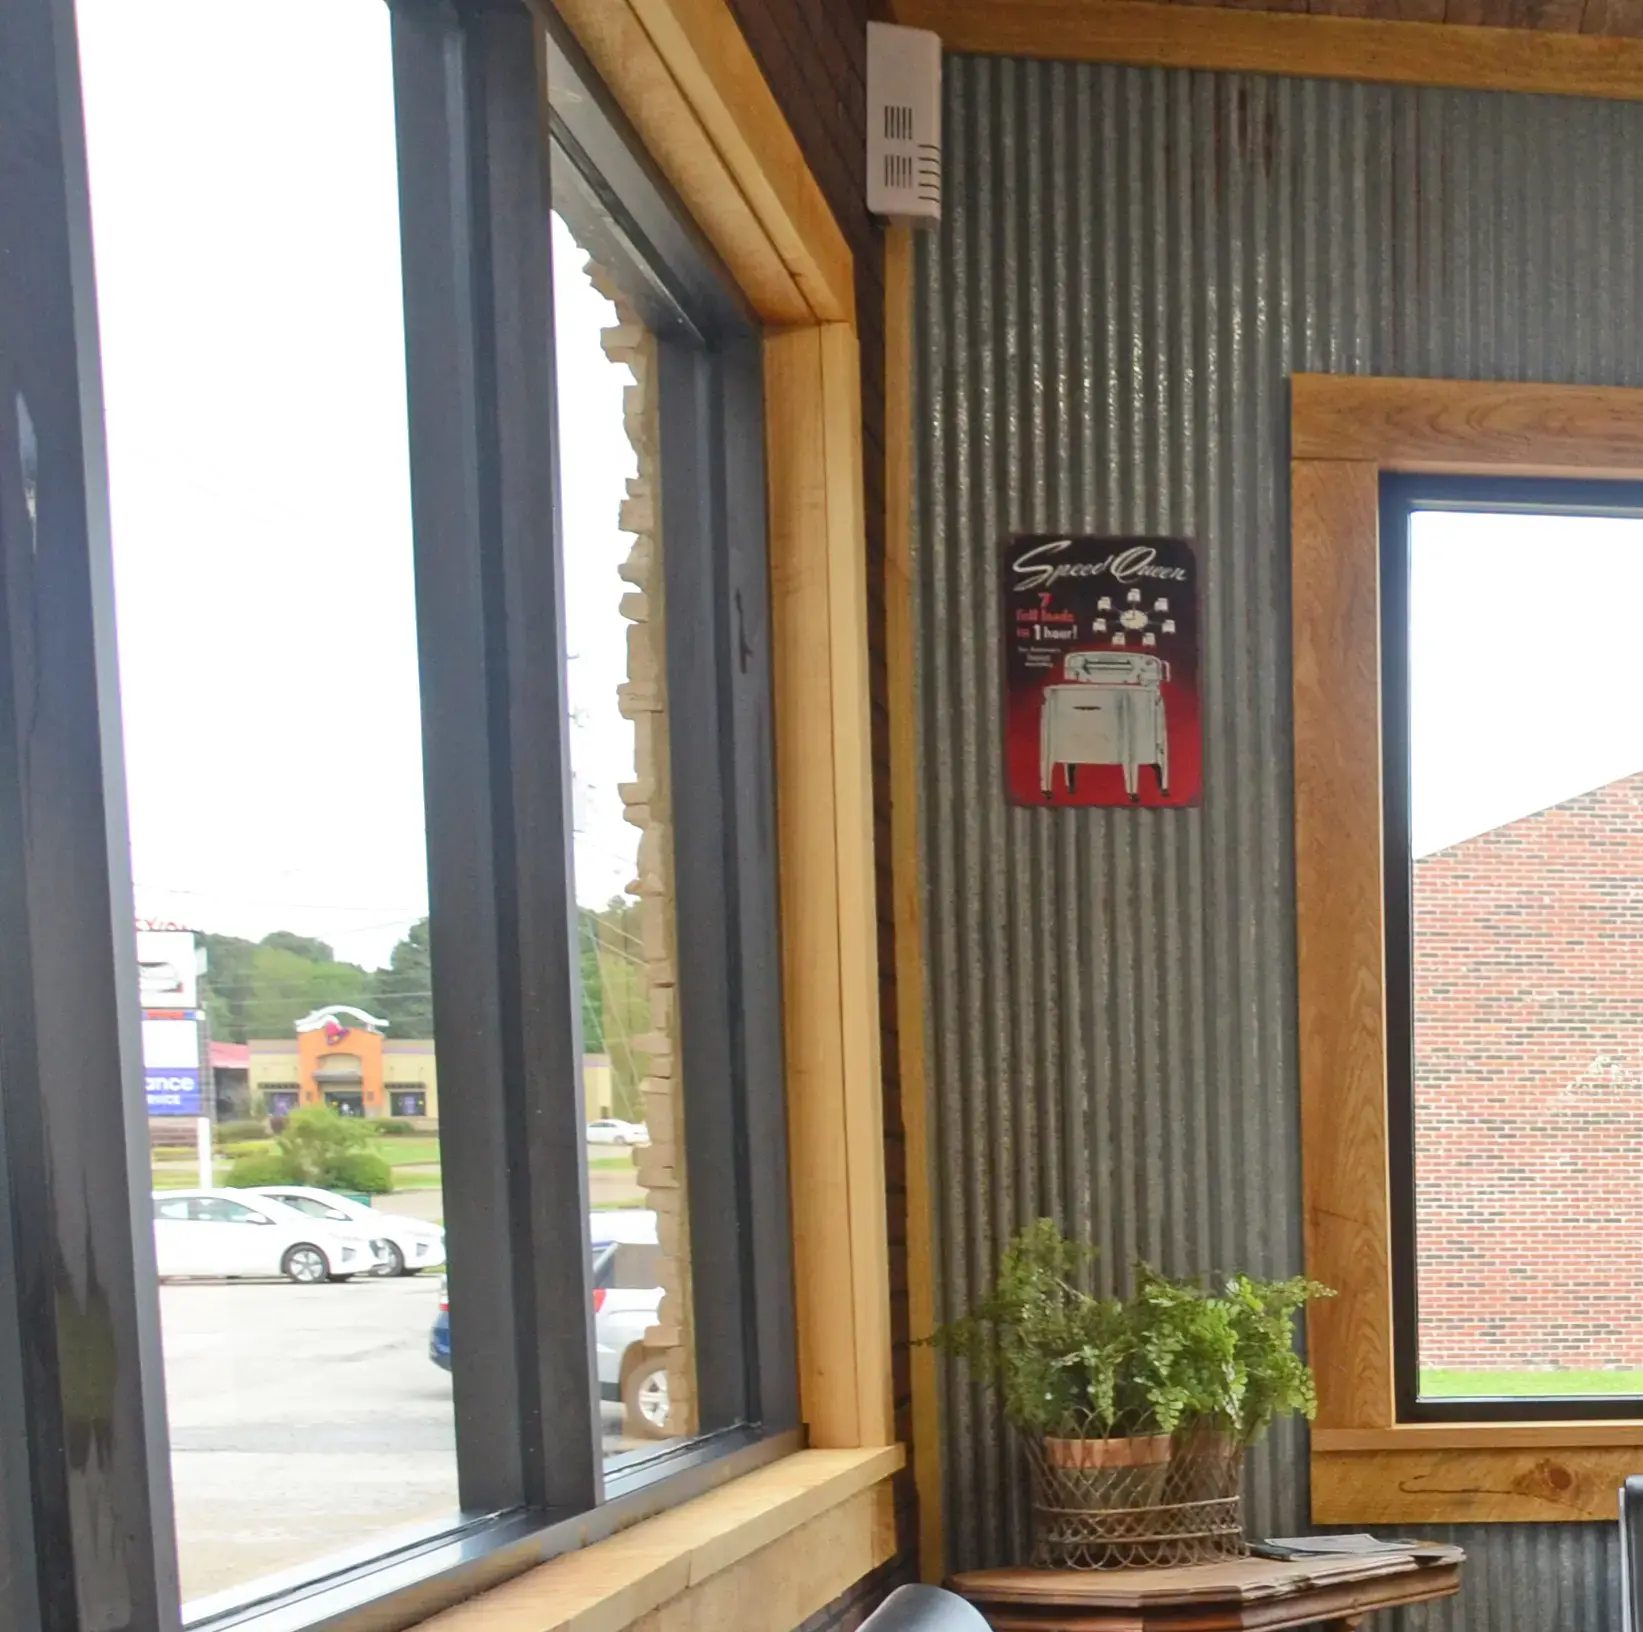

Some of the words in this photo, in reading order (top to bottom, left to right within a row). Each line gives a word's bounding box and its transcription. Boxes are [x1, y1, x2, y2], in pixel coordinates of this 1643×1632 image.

[1012, 540, 1113, 591] Speed
[1110, 546, 1187, 583] Queen
[1038, 592, 1053, 608] 7
[1033, 624, 1041, 640] 1
[1043, 624, 1078, 639] hour!
